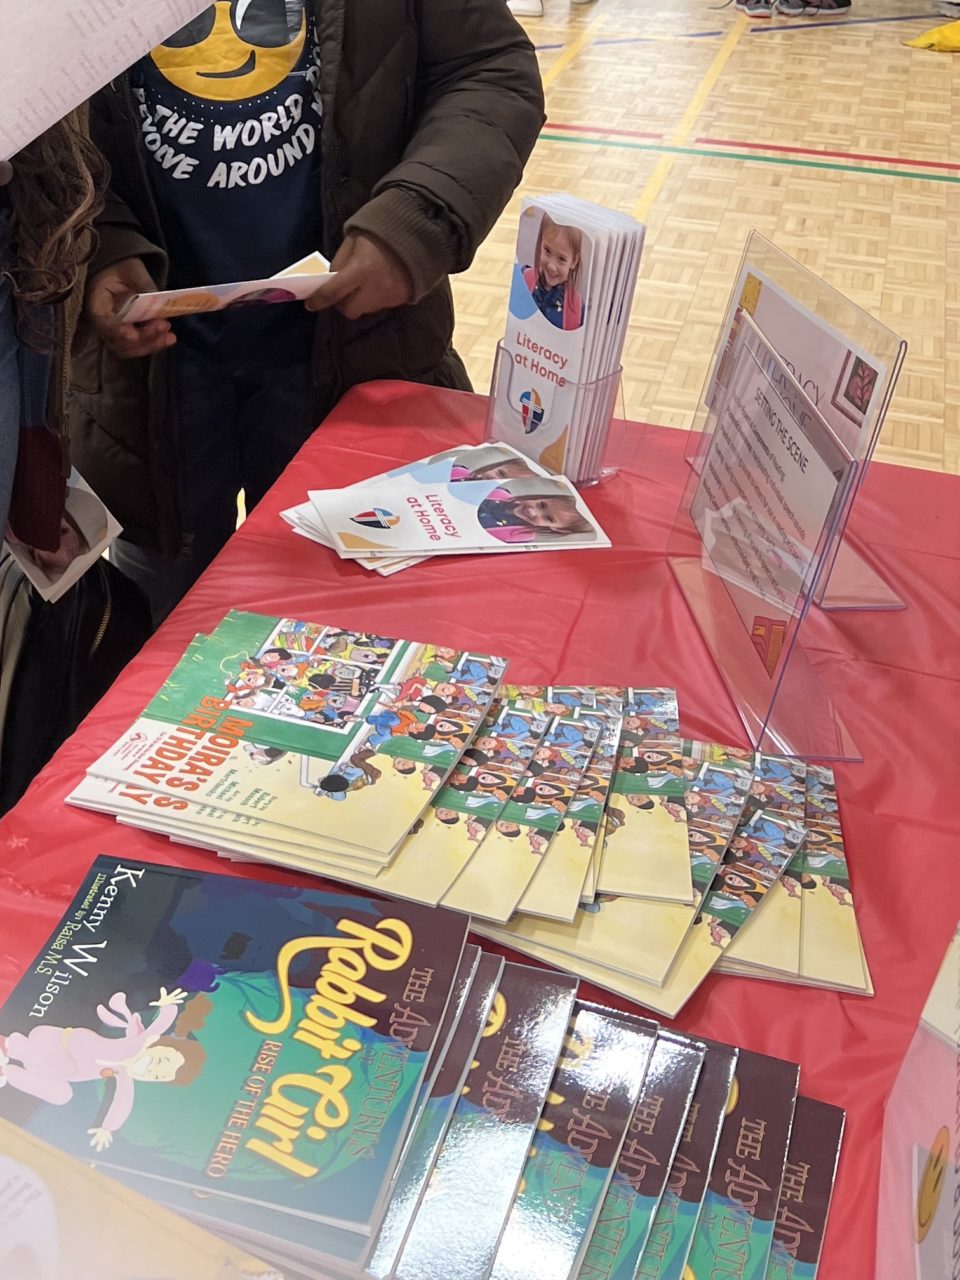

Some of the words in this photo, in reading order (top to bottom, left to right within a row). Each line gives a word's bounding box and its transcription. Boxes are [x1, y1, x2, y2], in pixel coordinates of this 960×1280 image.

[154, 103, 205, 146] THE
[212, 93, 305, 152] WORLD
[206, 122, 316, 189] AROUND
[514, 352, 529, 369] at
[530, 358, 567, 388] Home
[515, 331, 569, 370] Literacy
[754, 387, 777, 427] SETTING
[775, 418, 789, 443] THE
[785, 440, 809, 474] SCENE
[406, 495, 422, 509] at
[414, 509, 442, 542] Home
[424, 493, 462, 539] Literacy
[132, 695, 233, 786] BIRTHDAY
[165, 716, 255, 793] MOIRA'S
[80, 872, 108, 910] Illustrated
[81, 864, 146, 933] Kenny
[50, 919, 83, 951] Raisa
[29, 939, 109, 1019] Wilson
[35, 950, 65, 975] M.S.
[402, 967, 435, 1003] THE
[245, 918, 413, 1060] Rabbit
[251, 1039, 283, 1074] RISE
[495, 1036, 524, 1072] THE
[242, 1075, 267, 1098] OF
[347, 1002, 432, 1160] ADVENTURES
[227, 1098, 257, 1129] THE
[245, 1063, 353, 1179] Girl
[204, 1132, 242, 1179] HERO
[735, 1116, 768, 1161] THE
[781, 1160, 812, 1204] THE
